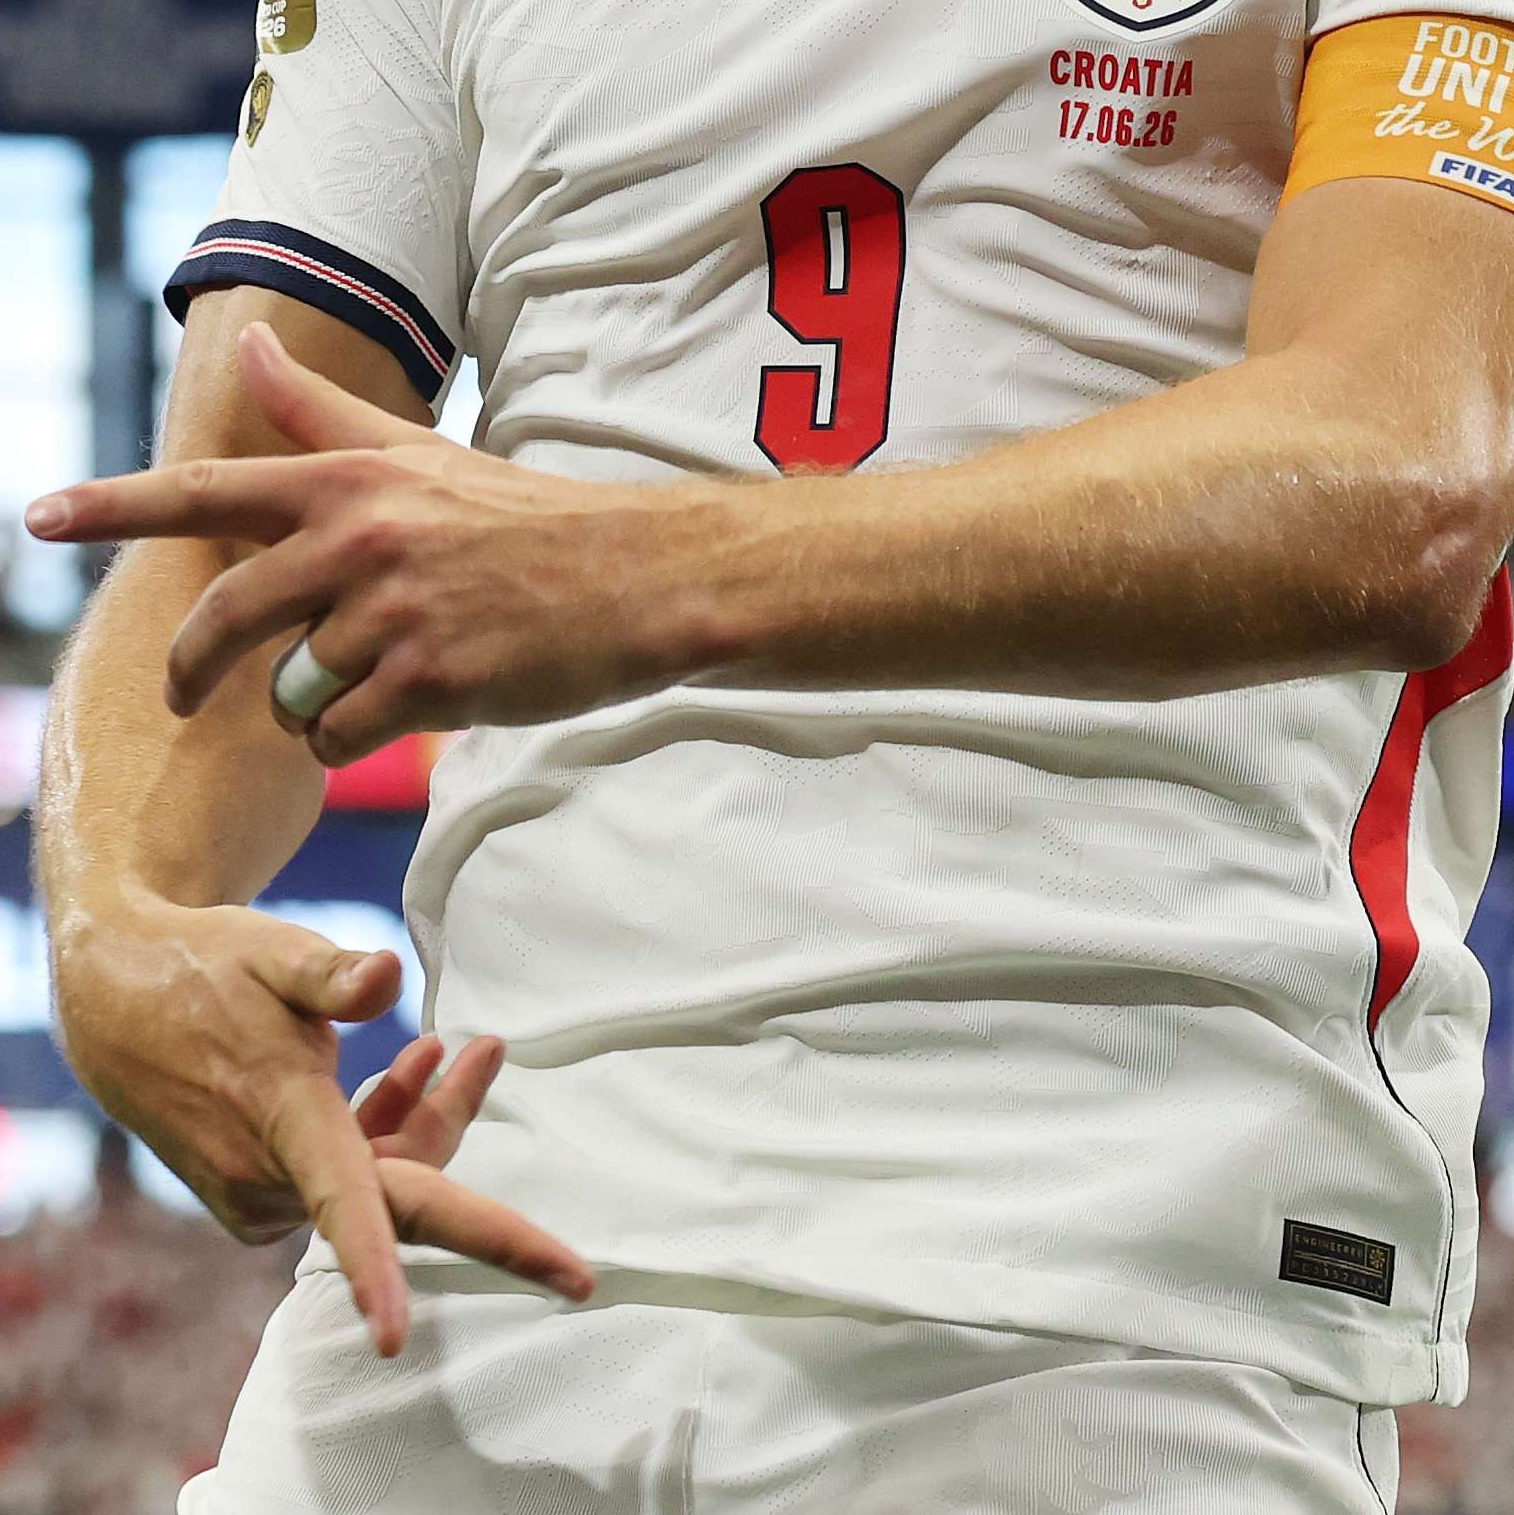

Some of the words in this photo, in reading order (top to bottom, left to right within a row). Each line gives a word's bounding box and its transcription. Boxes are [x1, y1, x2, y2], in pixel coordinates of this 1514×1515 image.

[1049, 49, 1193, 97] CROATIA
[1059, 99, 1177, 148] 17.06.26
[1374, 100, 1461, 140] the
[753, 162, 907, 478] 9
